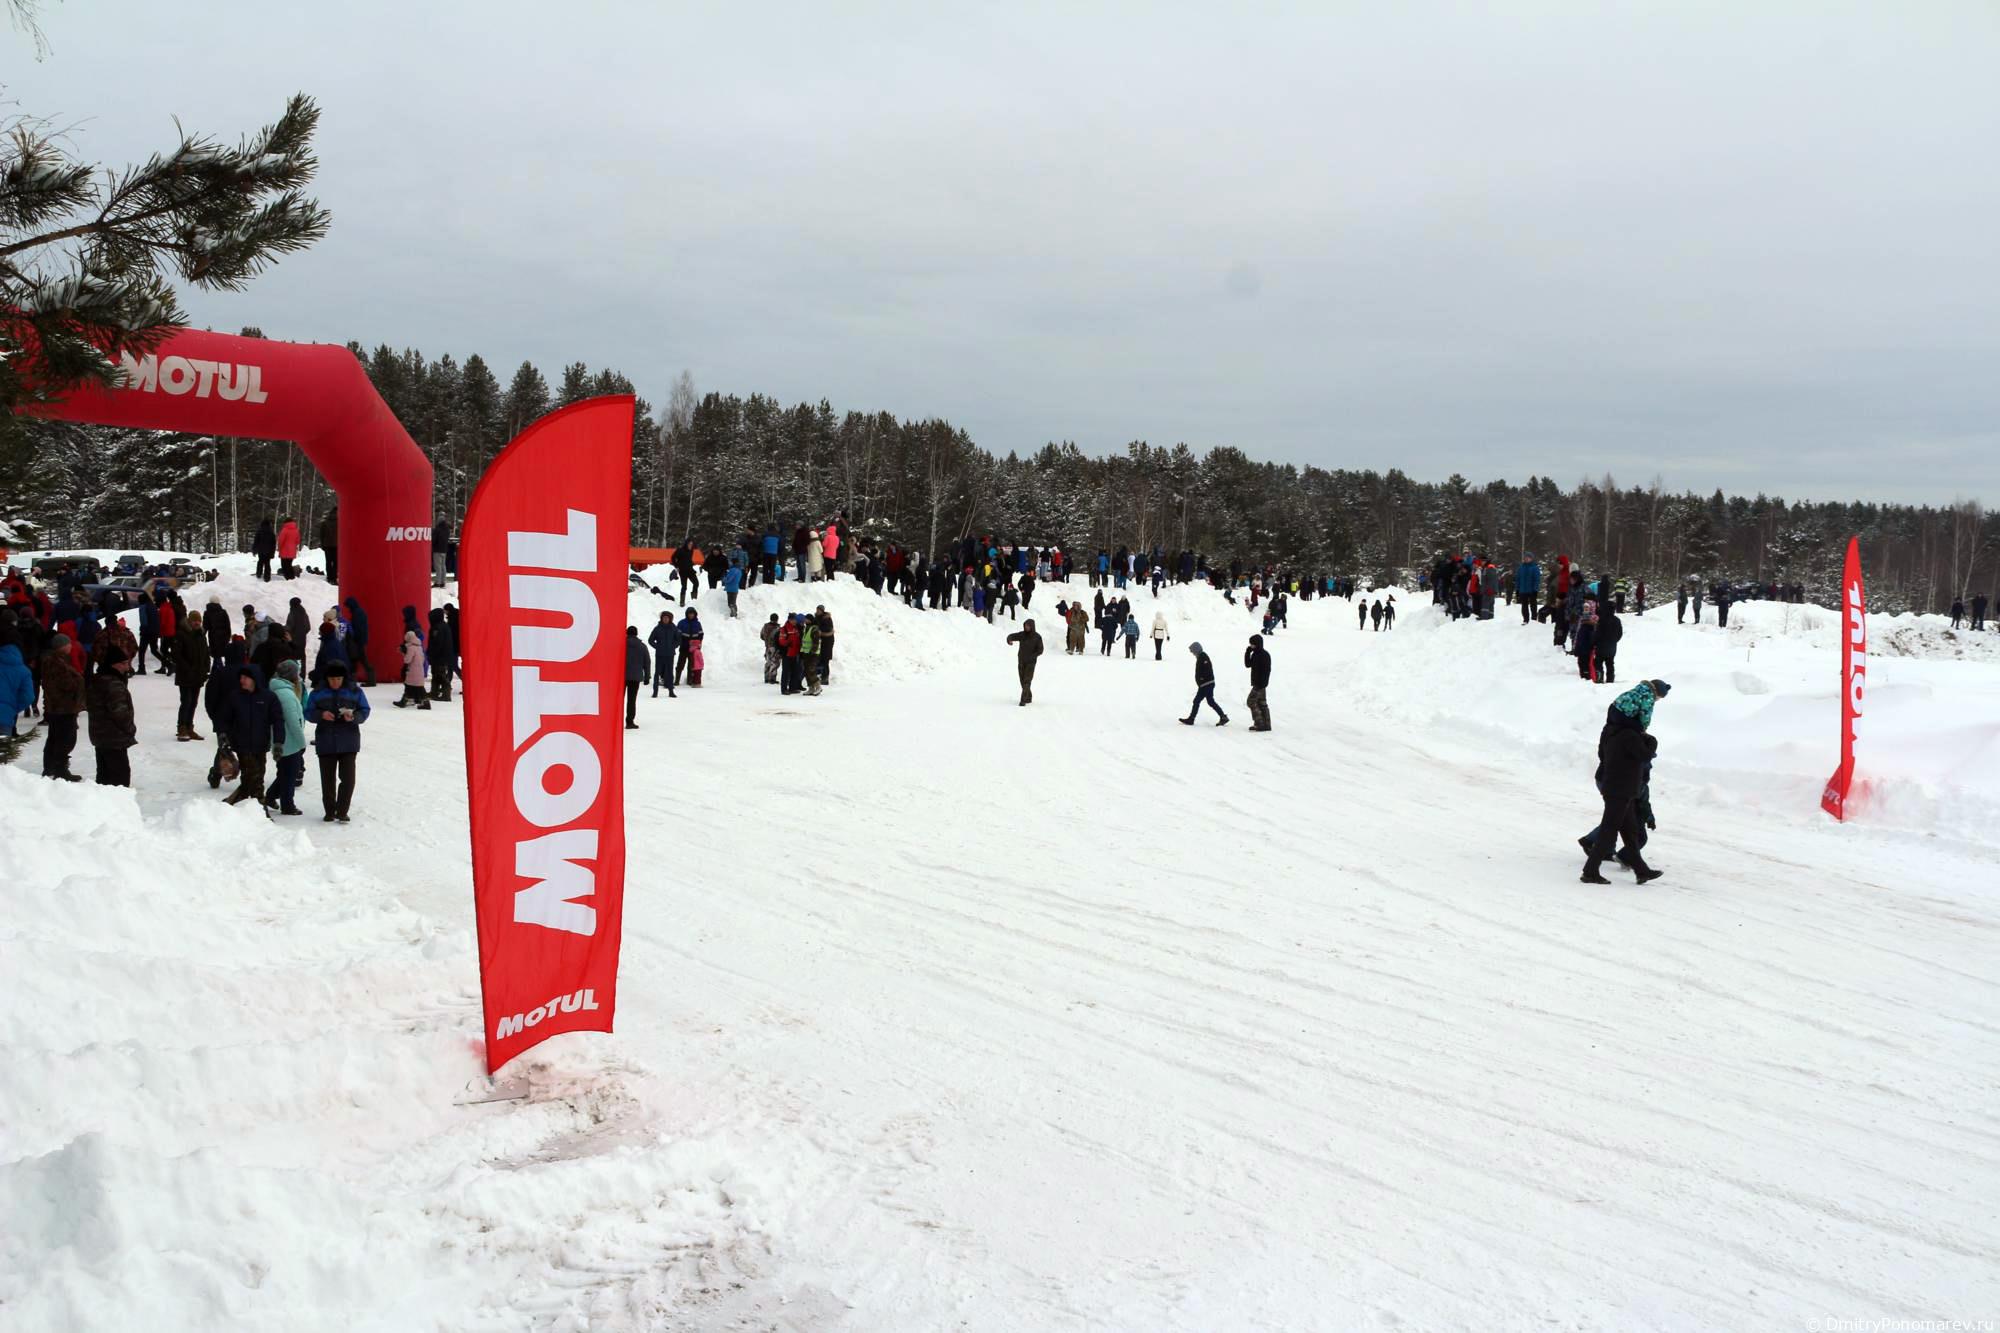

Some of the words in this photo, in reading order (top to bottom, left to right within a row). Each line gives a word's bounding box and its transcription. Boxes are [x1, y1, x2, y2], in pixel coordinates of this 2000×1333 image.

[112, 350, 268, 403] MOTUL
[385, 527, 432, 541] MOTU
[507, 509, 601, 936] MOTUL
[497, 989, 599, 1040] MOTUL
